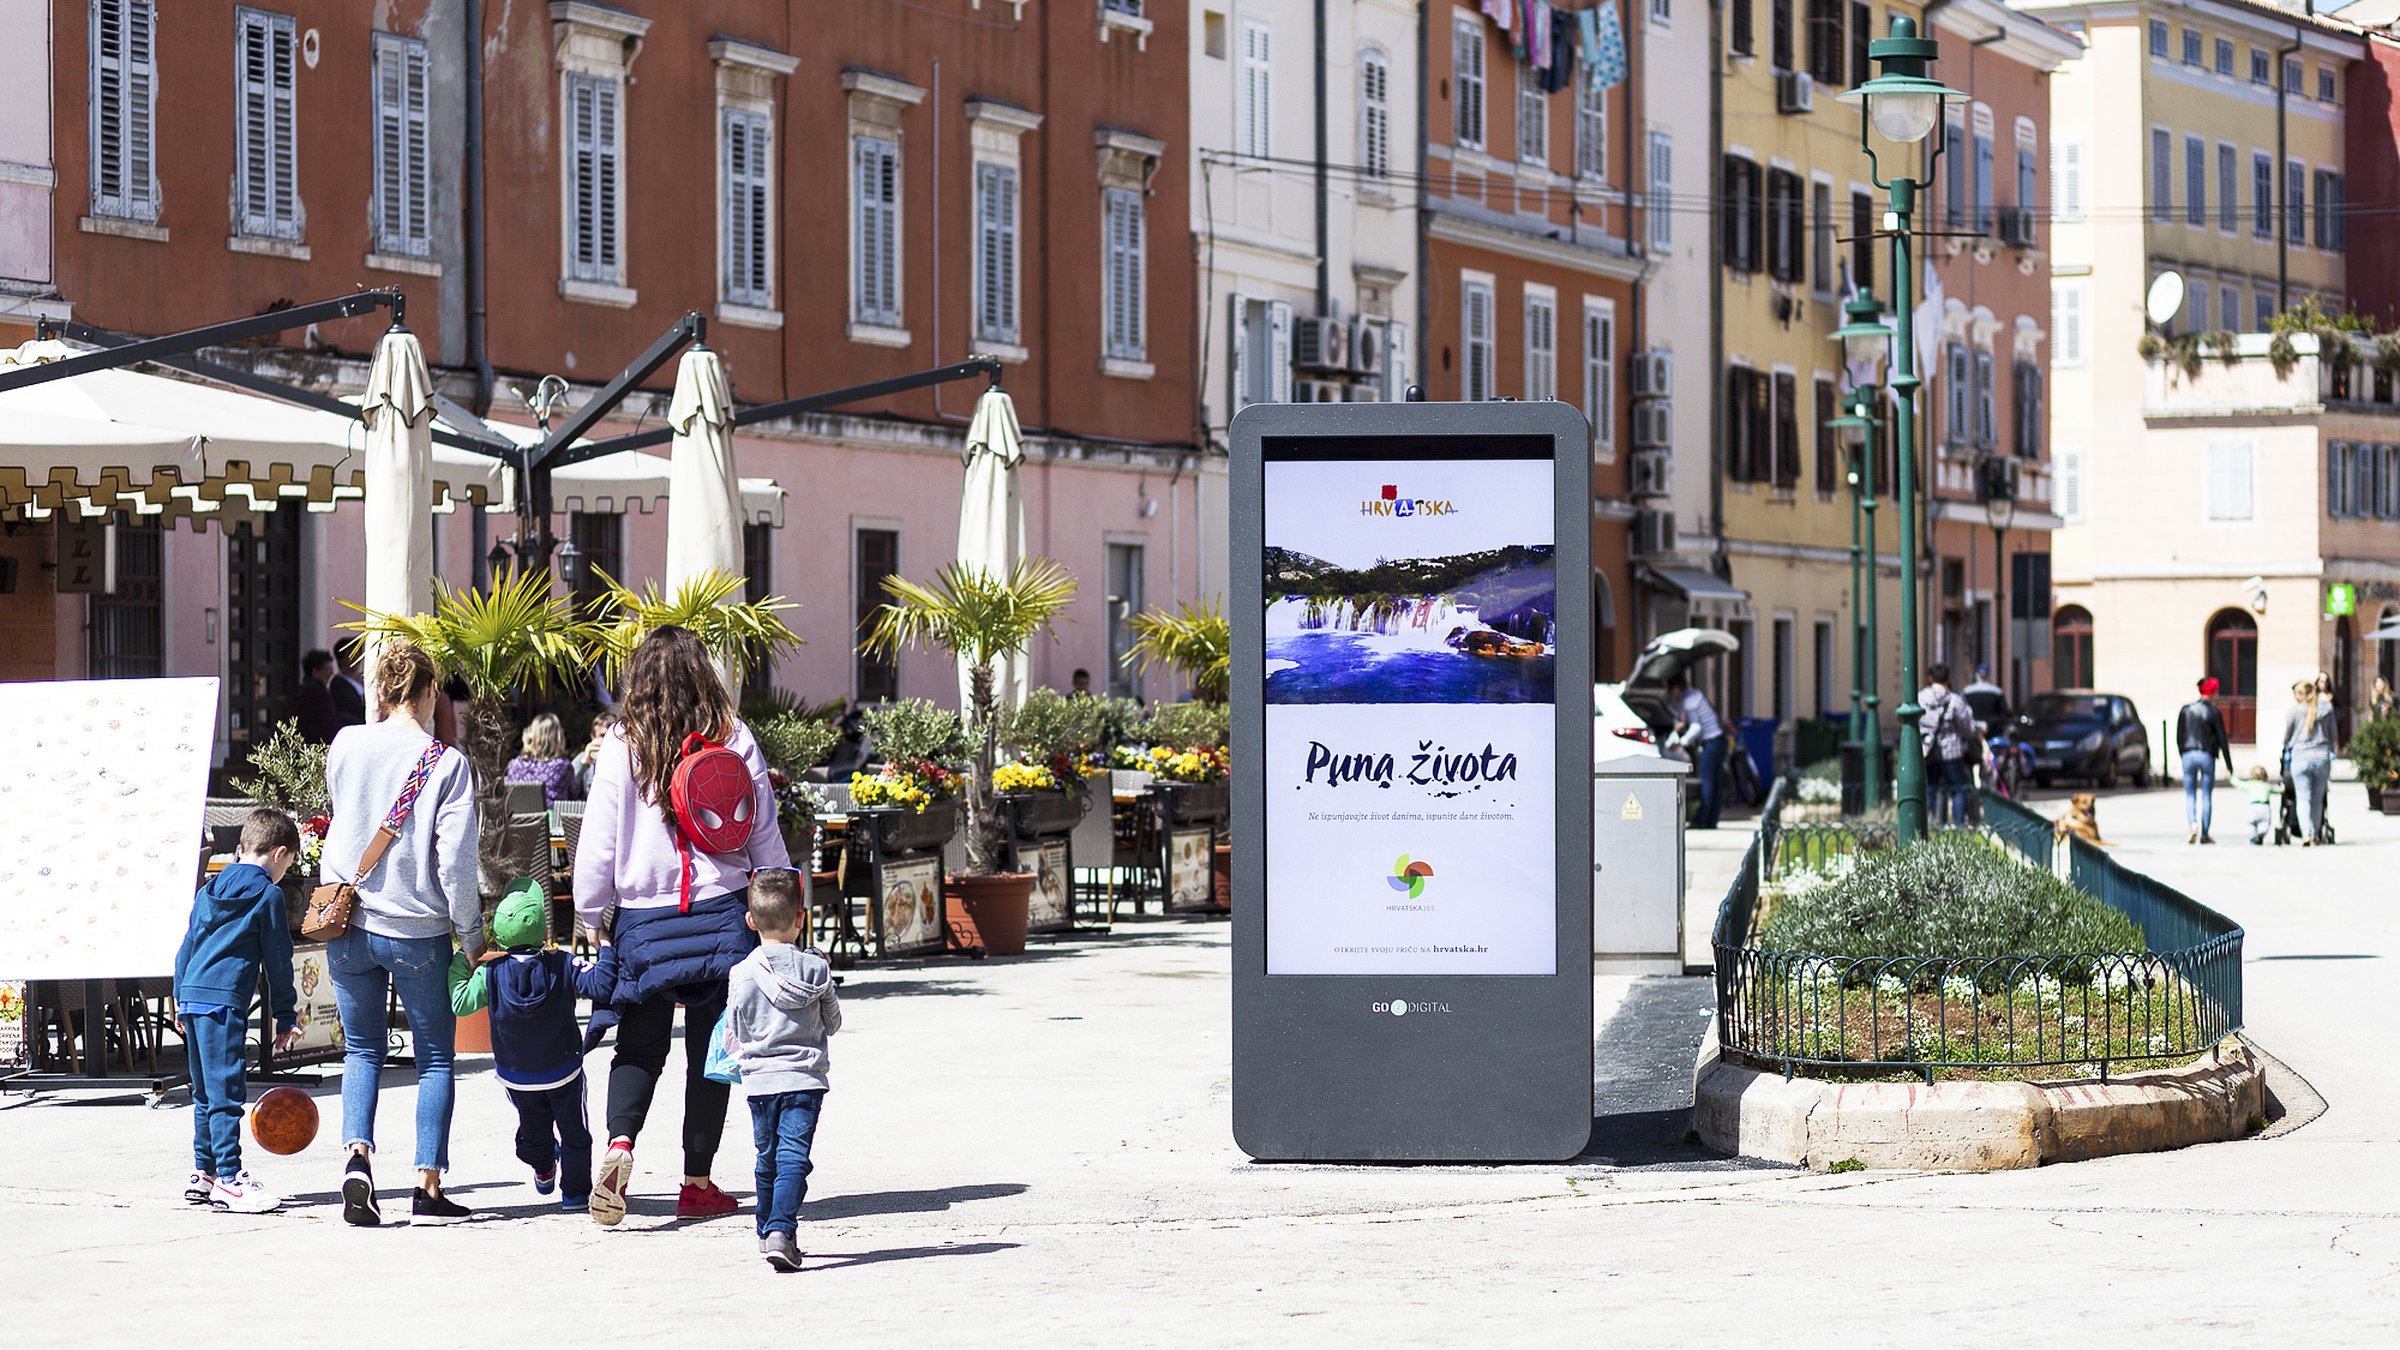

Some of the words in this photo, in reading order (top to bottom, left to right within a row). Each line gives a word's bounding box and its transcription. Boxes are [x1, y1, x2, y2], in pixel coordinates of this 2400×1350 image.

[1360, 499, 1458, 517] HRVATSKA
[1305, 741, 1394, 788] Puna
[1406, 740, 1517, 785] života
[1308, 811, 1319, 821] Ne
[1320, 811, 1368, 822] ispunjavajte
[1370, 811, 1389, 821] život
[1391, 811, 1424, 822] danima,
[1426, 811, 1457, 822] ispunite
[1459, 811, 1478, 821] dane
[1480, 811, 1514, 821] životom.
[1433, 944, 1488, 953] hrvatska.hr
